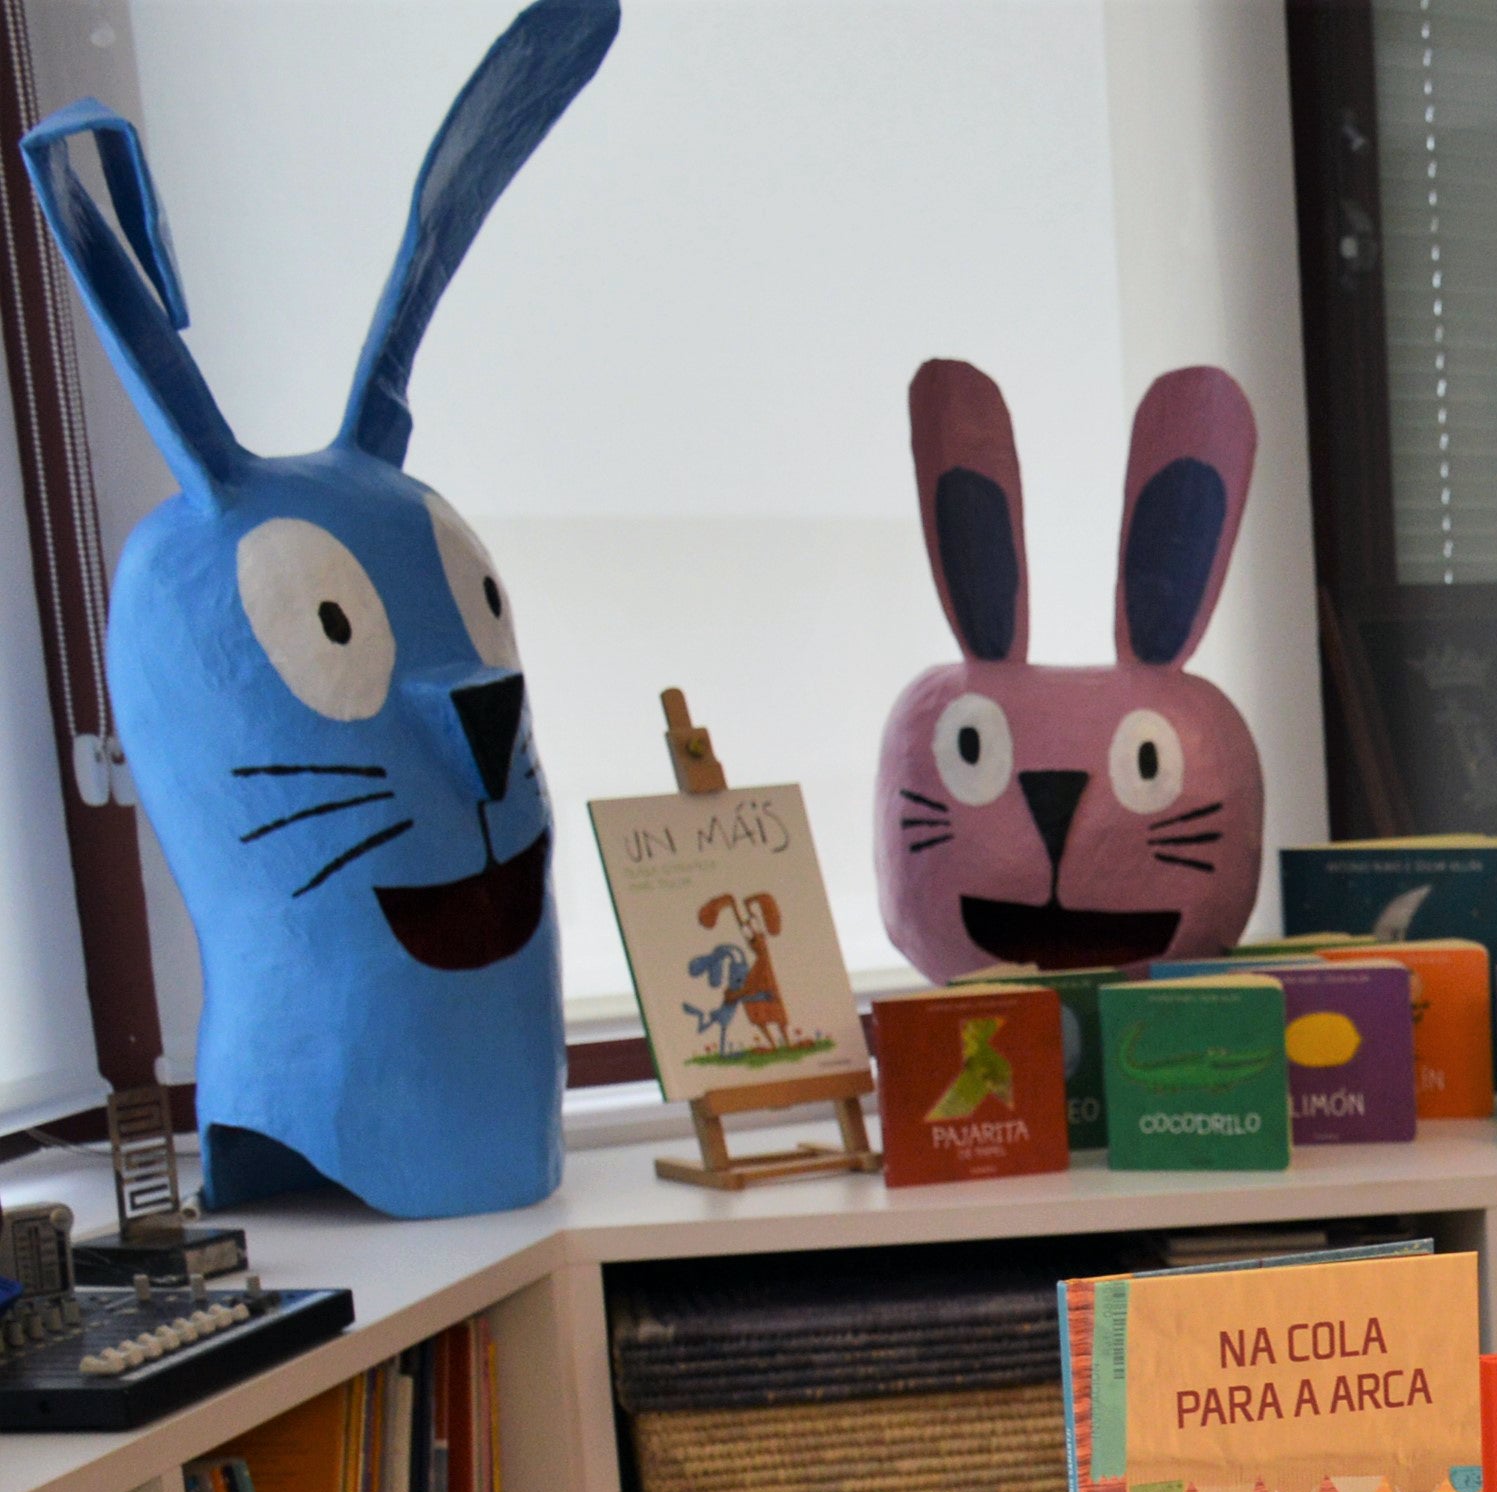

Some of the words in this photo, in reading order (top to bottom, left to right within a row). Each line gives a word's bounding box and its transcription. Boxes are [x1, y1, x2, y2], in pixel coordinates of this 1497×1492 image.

[625, 827, 677, 863] UN
[1289, 1089, 1365, 1119] LIMÓN
[932, 1121, 1030, 1149] PAJARITA
[1139, 1112, 1262, 1136] COCODRILO
[1220, 1328, 1276, 1368] NA
[1288, 1317, 1388, 1363] COLA
[1176, 1382, 1284, 1429] PARA
[1294, 1378, 1321, 1417] A
[1330, 1368, 1433, 1414] ARCA
